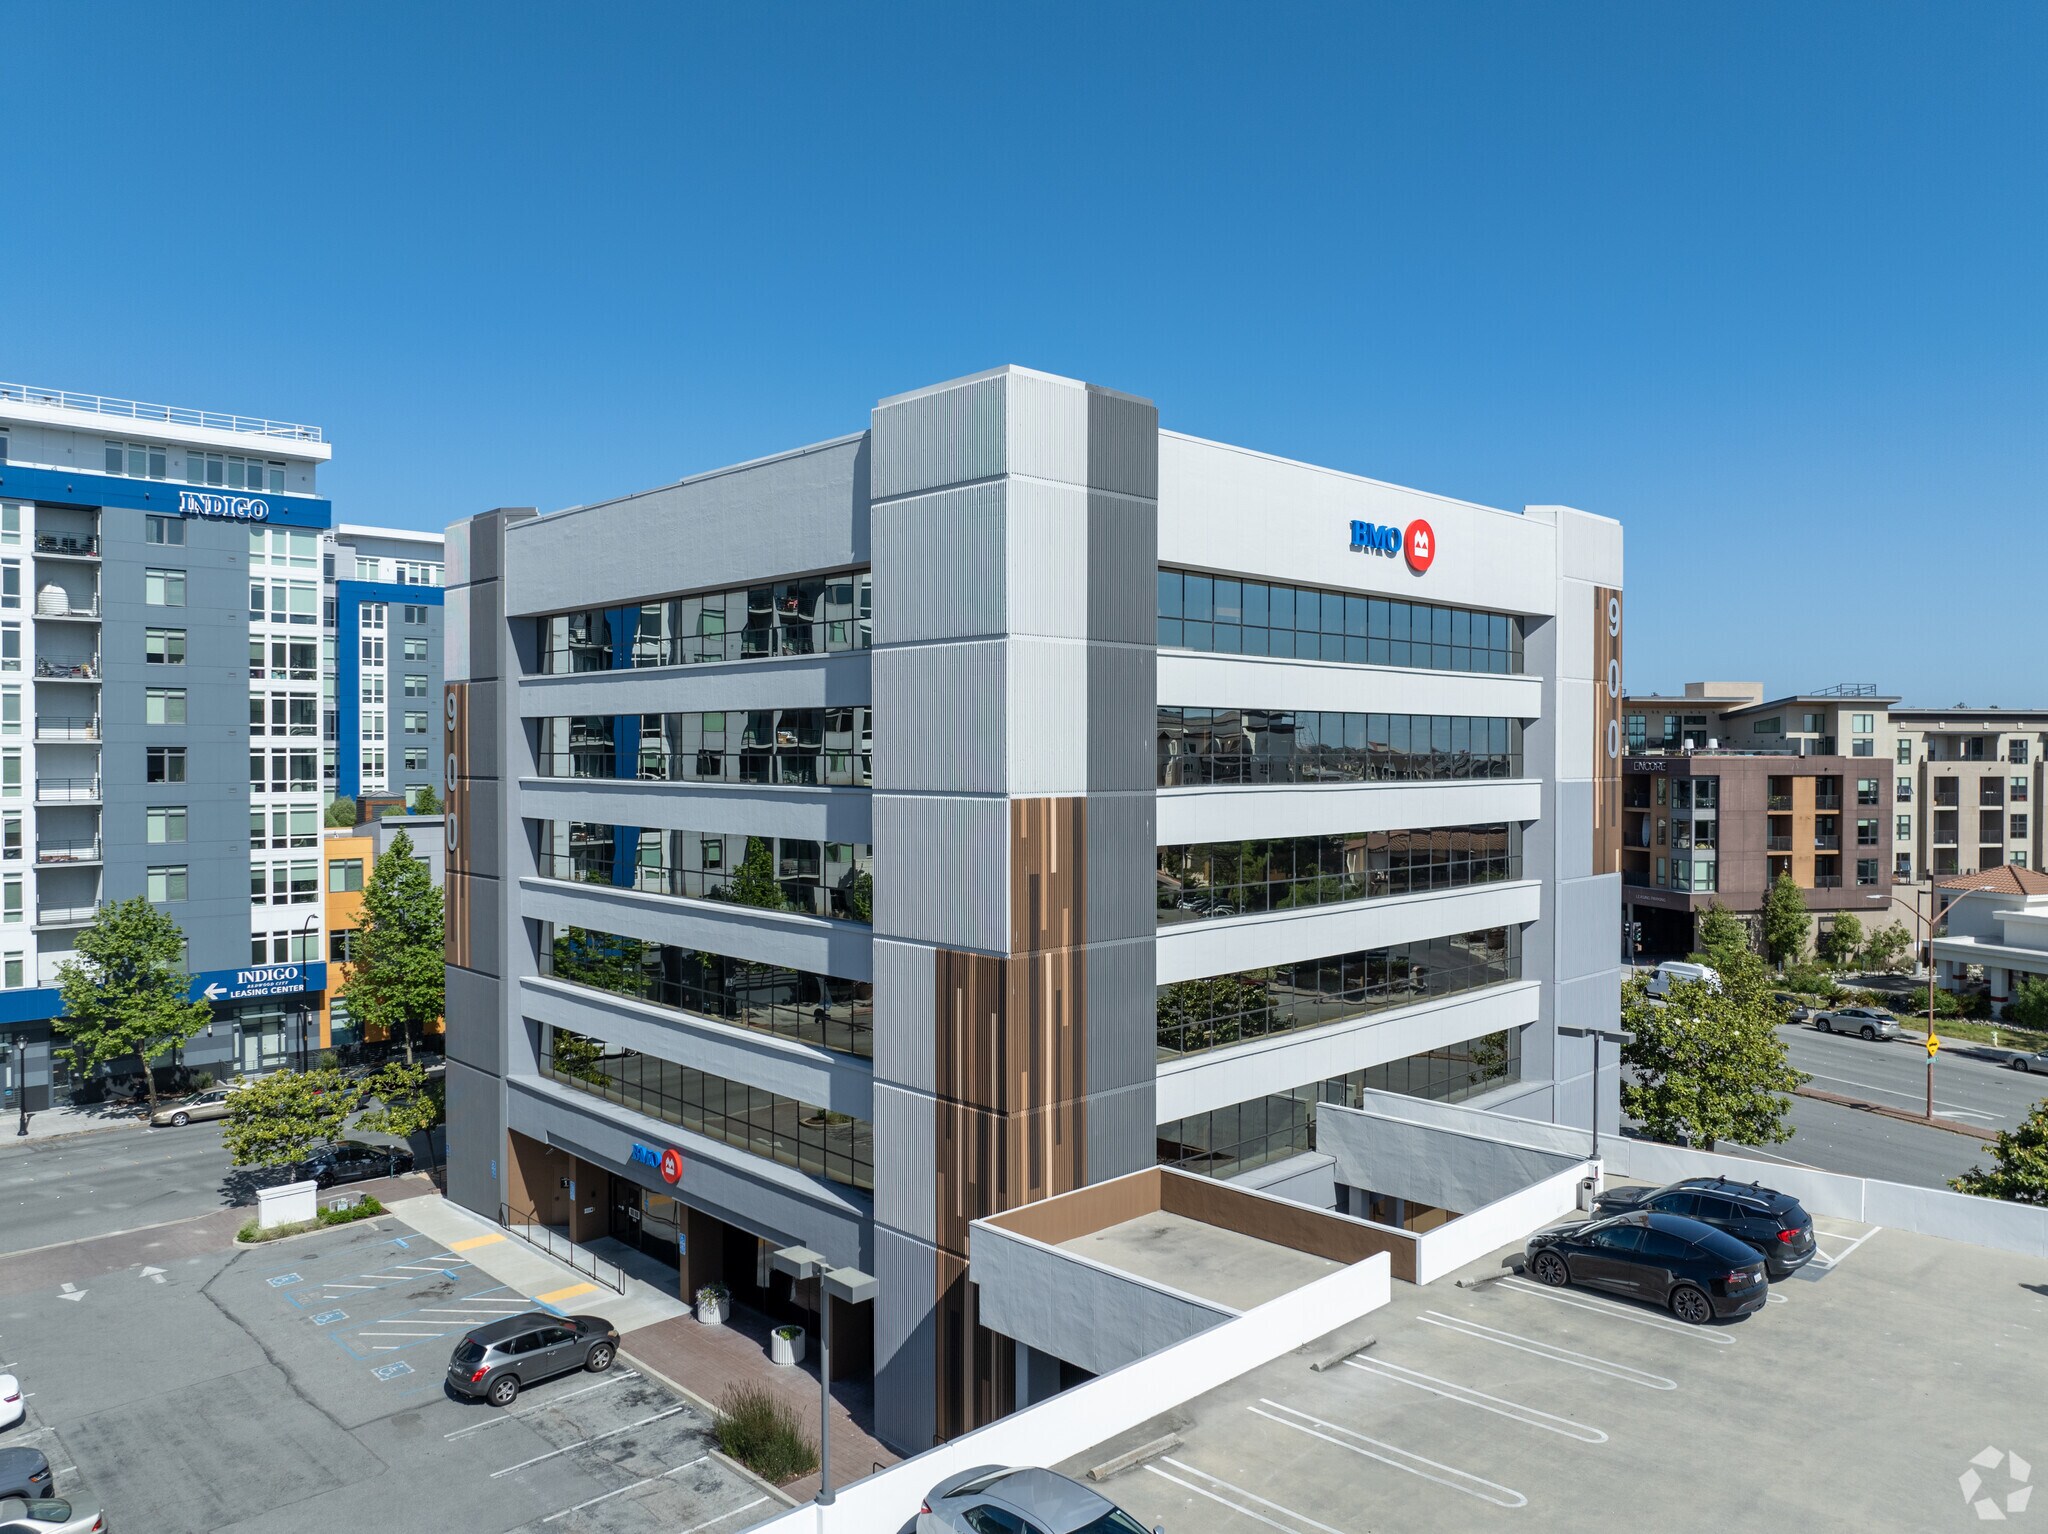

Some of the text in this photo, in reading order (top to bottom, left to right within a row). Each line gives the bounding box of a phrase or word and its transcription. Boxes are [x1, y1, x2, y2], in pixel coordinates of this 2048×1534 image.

[179, 491, 269, 520] INDIGO
[1350, 520, 1402, 552] BMO
[1608, 598, 1620, 759] 900
[447, 692, 458, 852] 900
[1633, 761, 1667, 771] ENCORE
[237, 967, 298, 985] INDIGO
[230, 984, 304, 998] LEASING CENTER
[632, 1144, 662, 1168] BMO
